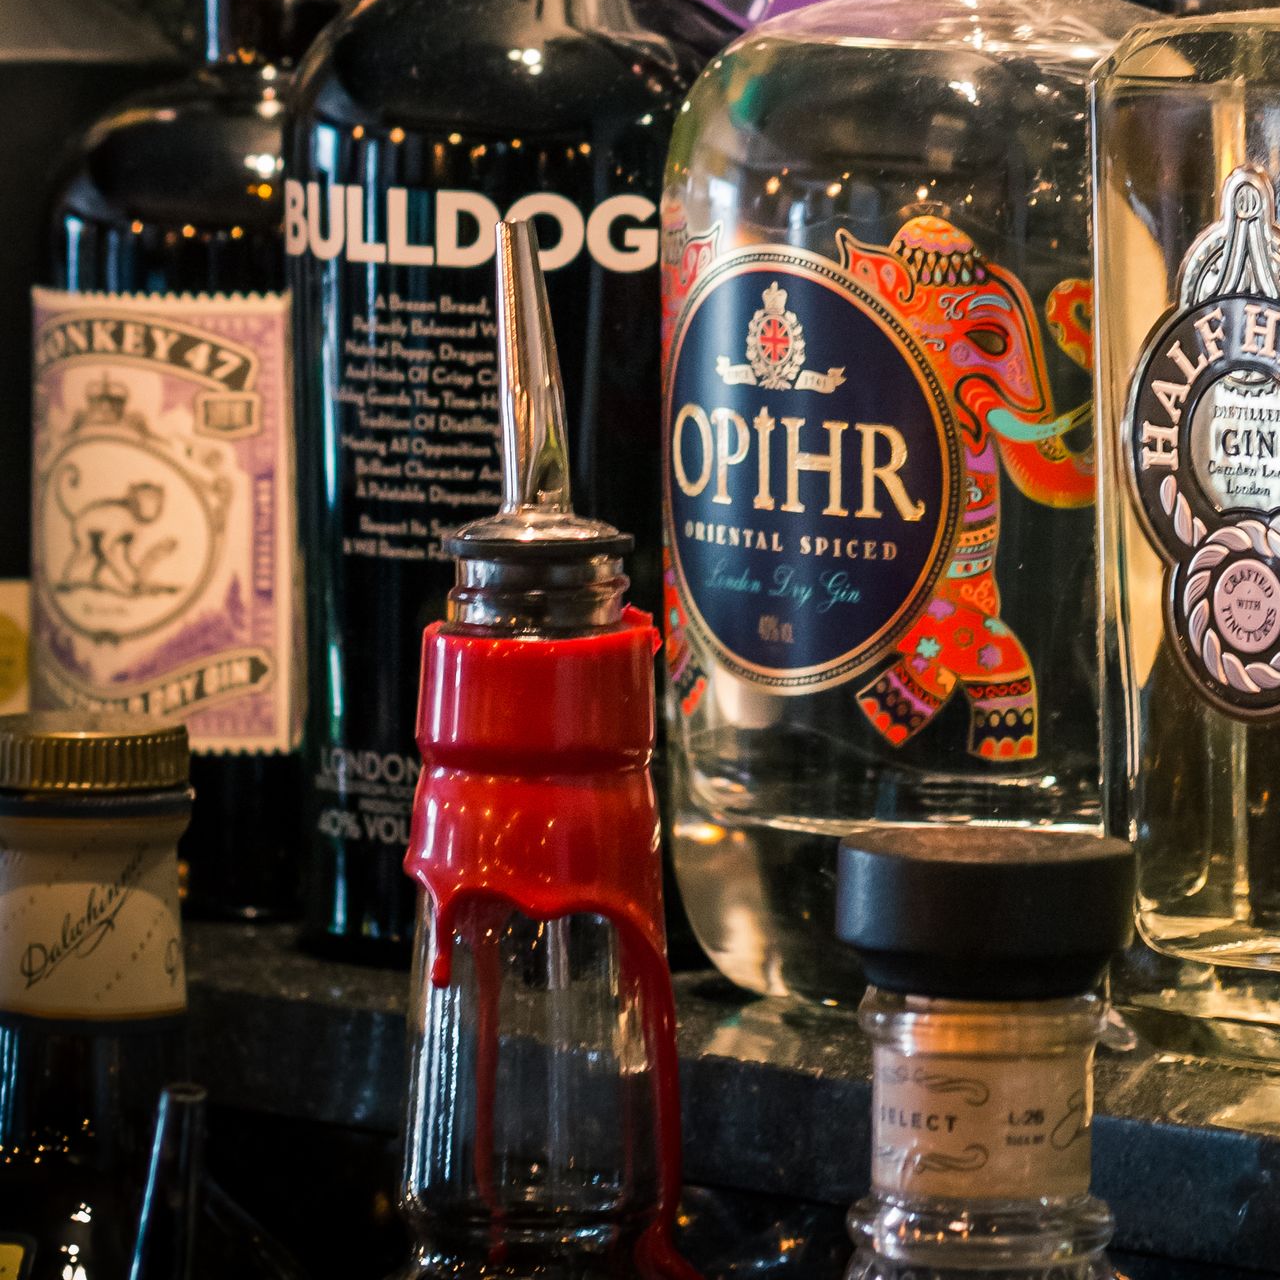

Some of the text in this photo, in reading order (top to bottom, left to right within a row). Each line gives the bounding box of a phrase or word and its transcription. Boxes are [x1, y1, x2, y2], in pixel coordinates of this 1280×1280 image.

[285, 178, 658, 273] BULLDOG
[184, 341, 243, 381] 47
[1142, 307, 1226, 471] HALF
[673, 403, 927, 522] OPIHR
[1221, 428, 1277, 459] GIN
[1226, 479, 1272, 497] London
[684, 520, 898, 561] ORIENTAL SPICED
[768, 562, 813, 609] Dry
[816, 571, 861, 614] Gin
[1224, 569, 1275, 599] CRAFTED
[1221, 604, 1277, 643] TINCTURES
[1236, 598, 1261, 611] WITH
